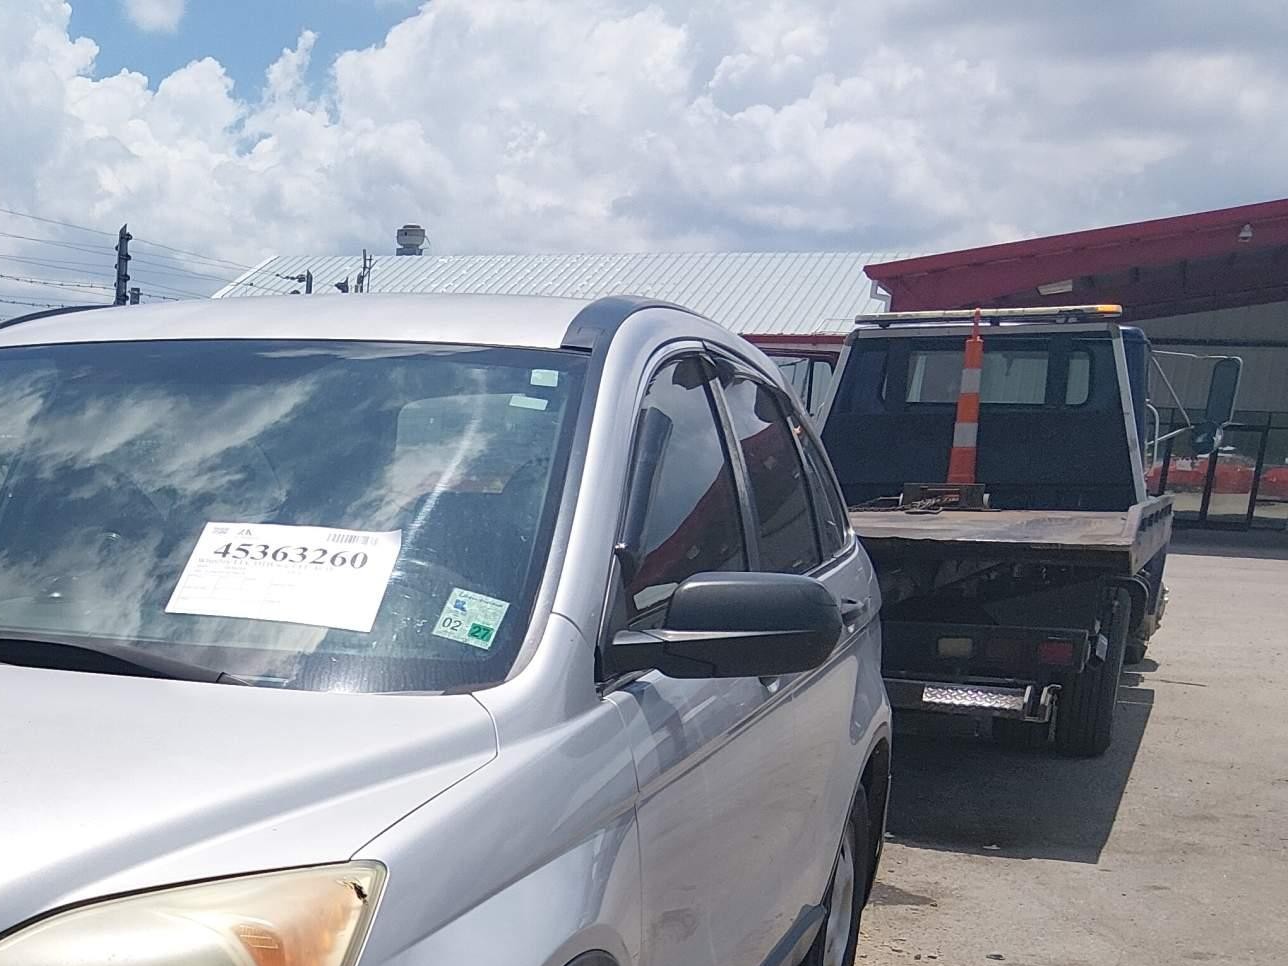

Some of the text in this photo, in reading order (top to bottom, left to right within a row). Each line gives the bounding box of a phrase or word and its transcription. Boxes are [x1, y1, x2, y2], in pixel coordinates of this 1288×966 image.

[213, 542, 369, 570] 45363260
[442, 617, 462, 632] 02
[470, 625, 491, 640] 27
